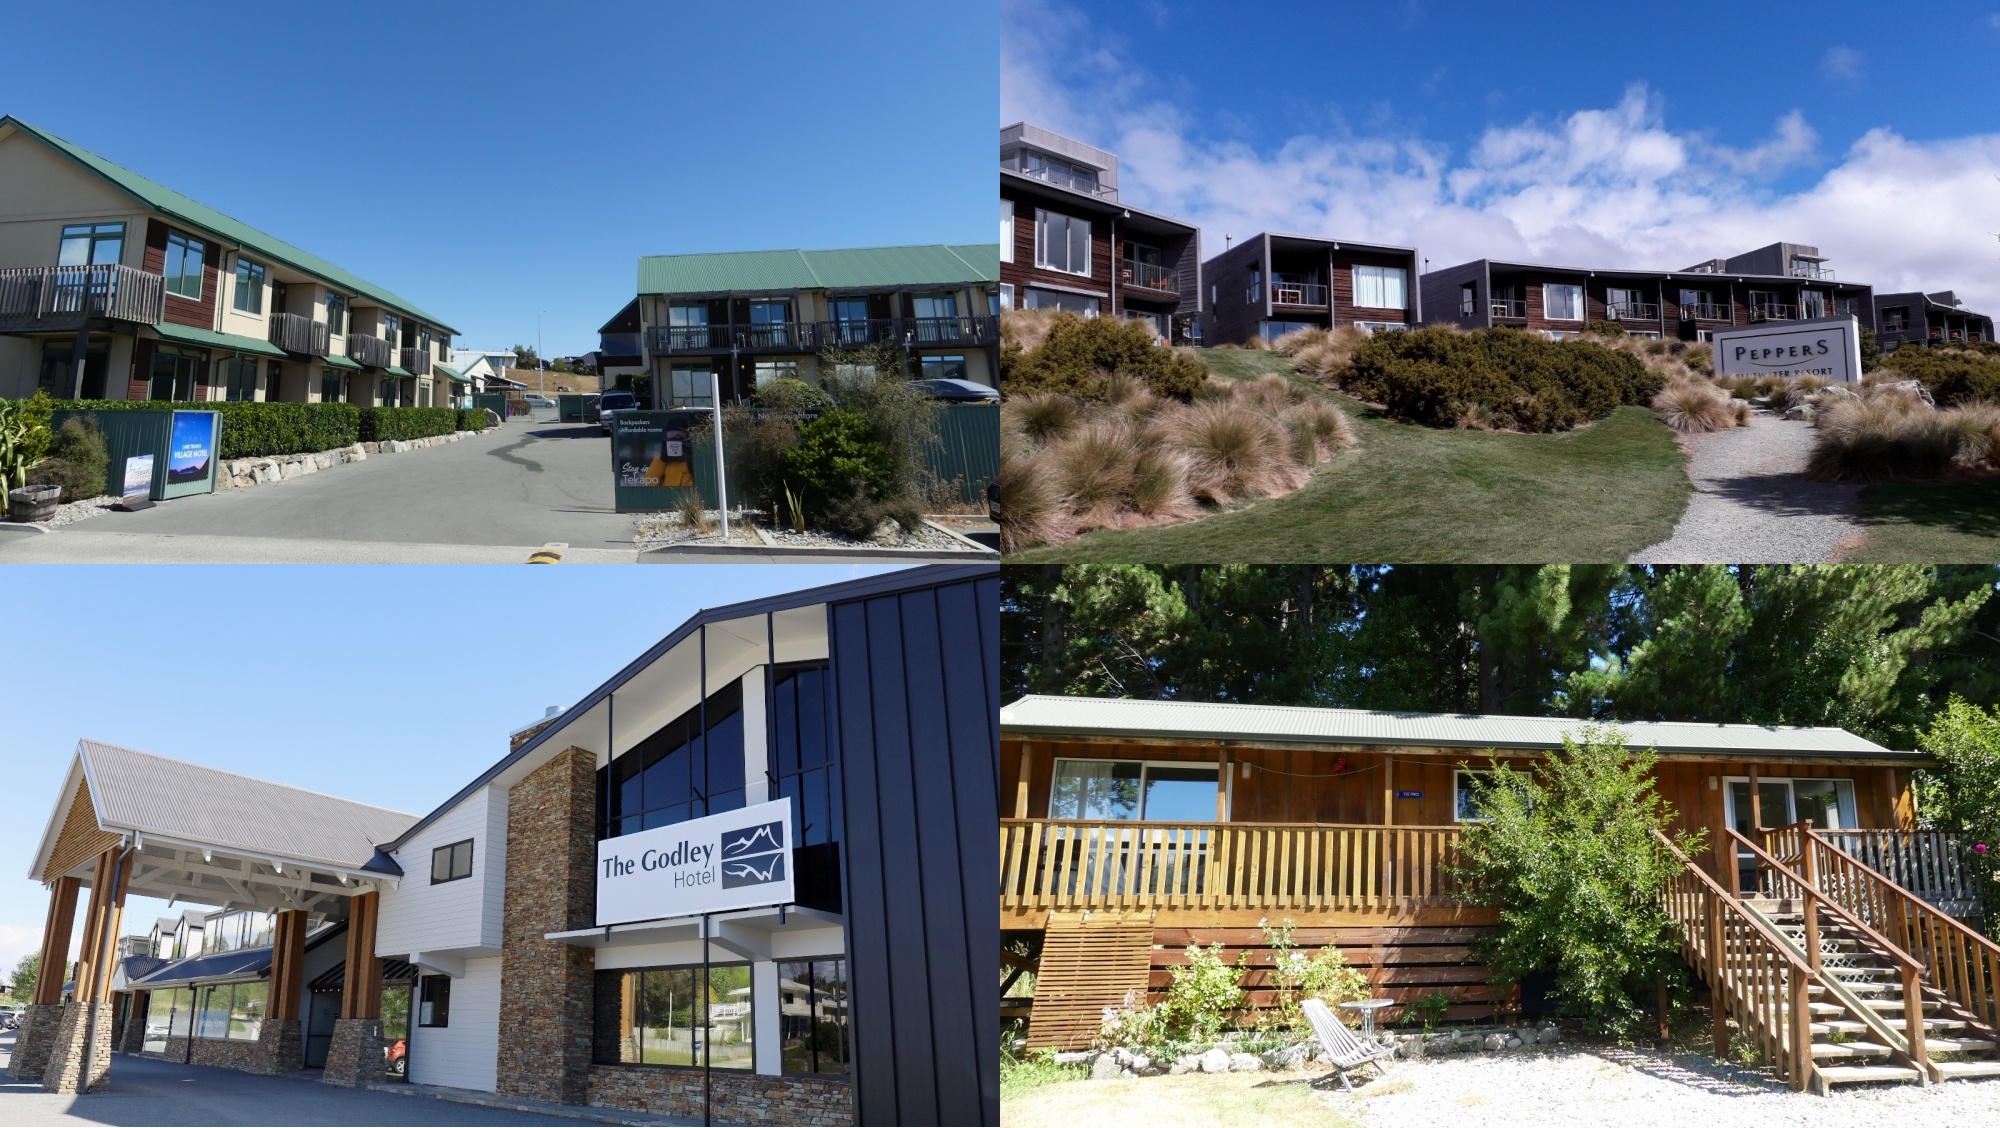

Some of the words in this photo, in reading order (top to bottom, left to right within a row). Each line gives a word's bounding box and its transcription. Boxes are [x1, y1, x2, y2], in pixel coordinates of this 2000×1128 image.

[1735, 339, 1829, 361] PEPPERS
[174, 450, 193, 459] VILLAGE
[193, 449, 208, 458] MOTEL
[622, 462, 640, 475] Stay
[622, 474, 659, 486] Tekapo
[602, 854, 635, 879] The
[641, 840, 715, 872] Godley
[674, 866, 715, 889] Hotel
